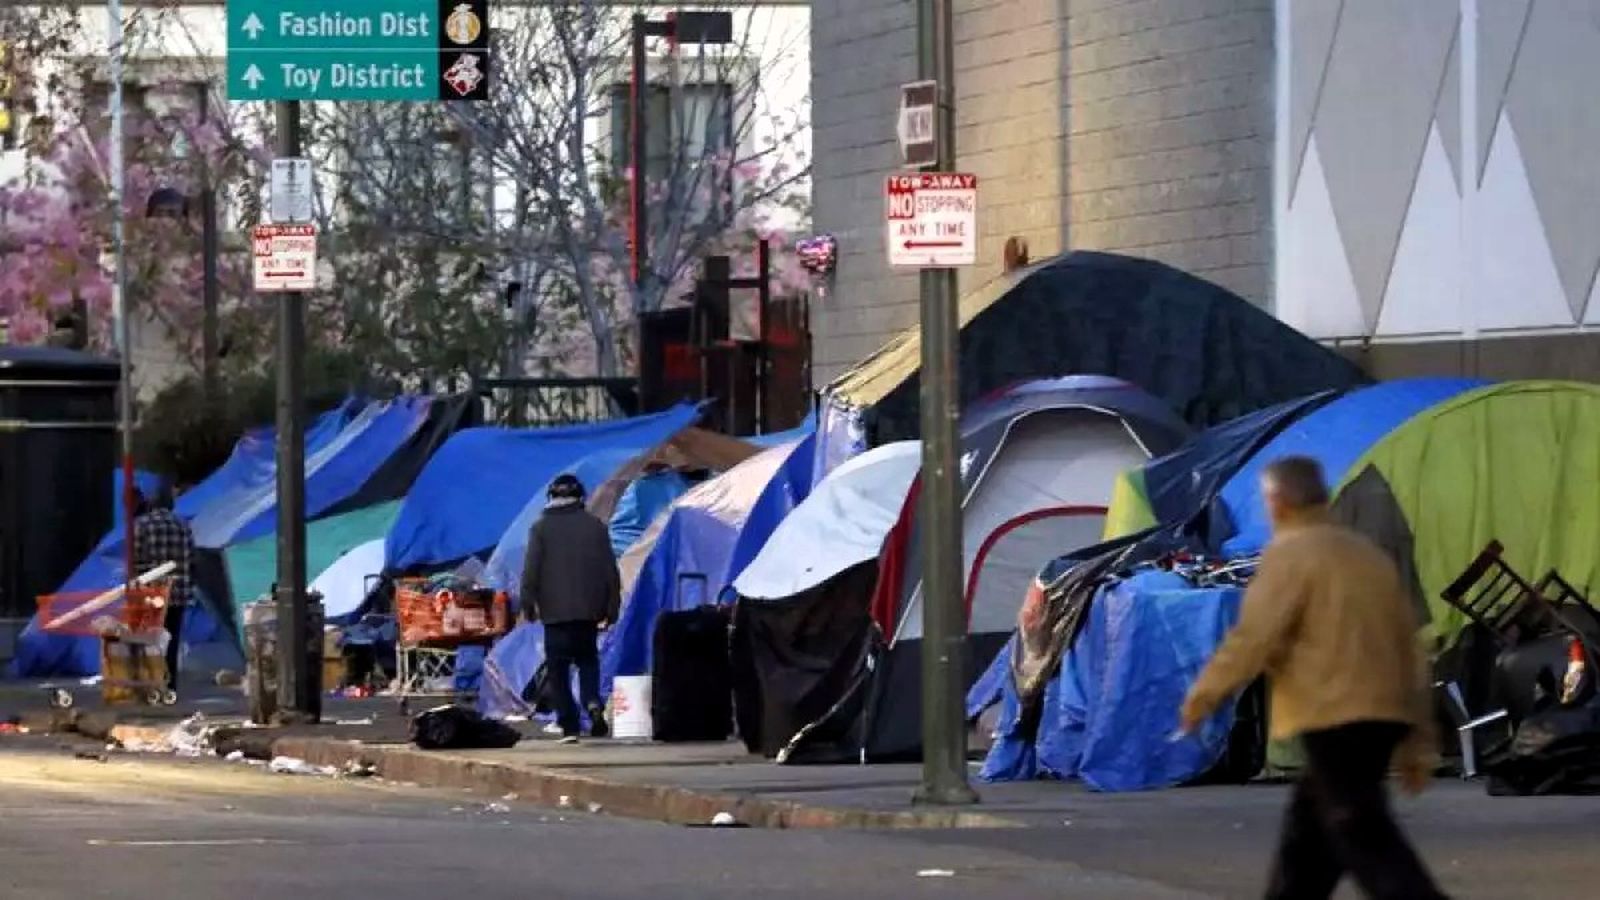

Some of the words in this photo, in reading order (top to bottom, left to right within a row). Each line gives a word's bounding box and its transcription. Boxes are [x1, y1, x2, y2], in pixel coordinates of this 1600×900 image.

[279, 12, 372, 36] Fashion
[381, 12, 430, 36] Dist
[280, 63, 321, 92] Toy
[331, 63, 425, 88] District
[890, 176, 974, 189] TOW-AWAY
[889, 193, 913, 217] NO
[918, 195, 973, 213] STOPPING
[899, 223, 925, 236] ANY
[935, 222, 966, 236] TIME
[255, 238, 271, 254] NO
